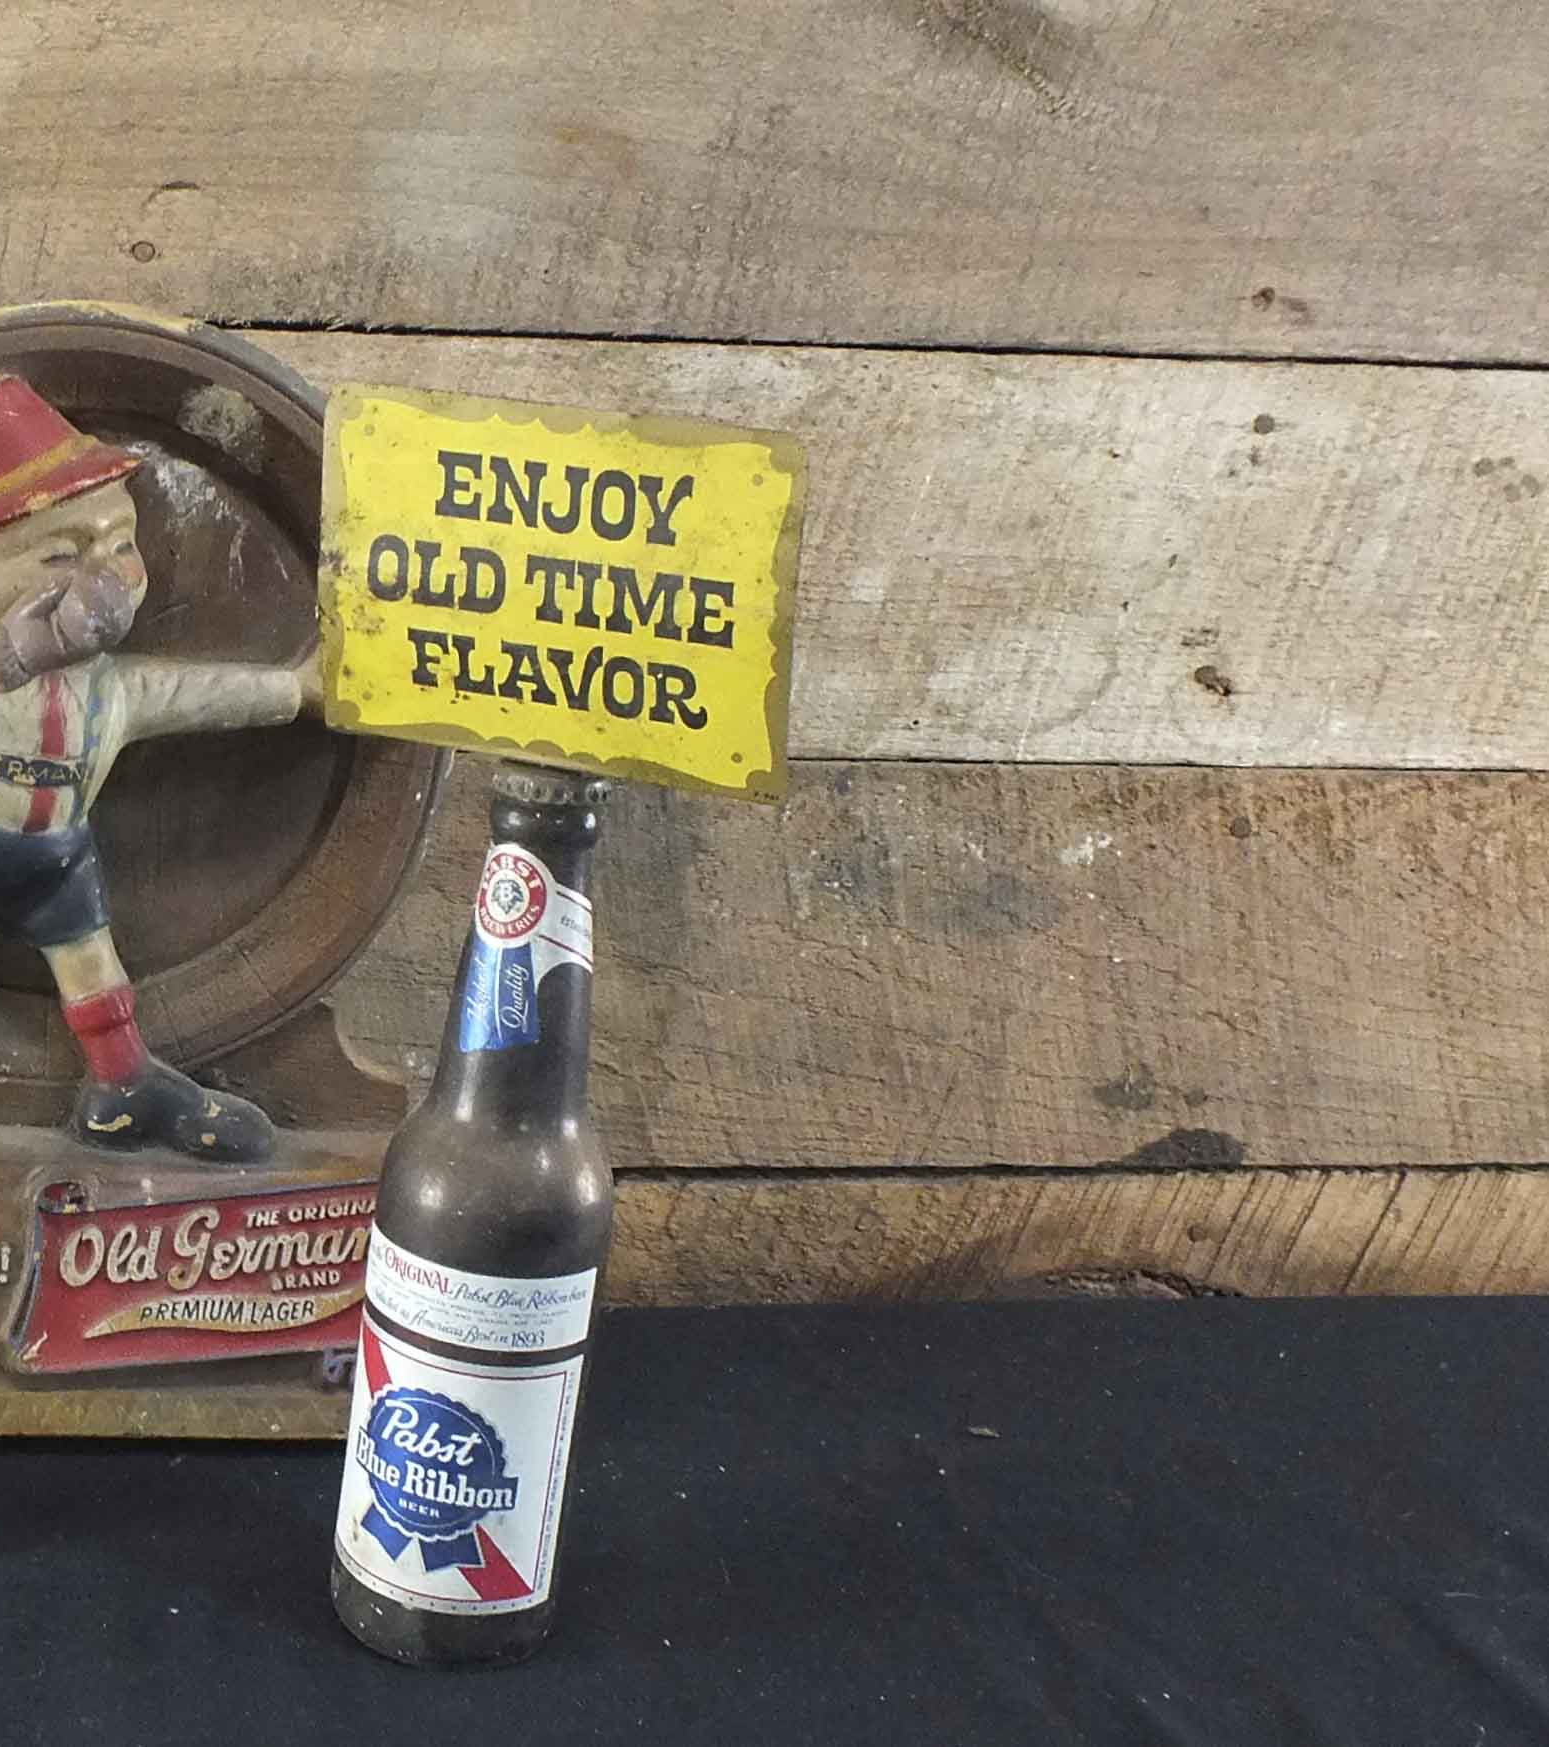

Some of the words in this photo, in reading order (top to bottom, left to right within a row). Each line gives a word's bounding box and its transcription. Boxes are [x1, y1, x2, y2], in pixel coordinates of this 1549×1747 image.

[435, 449, 694, 546] ENJOY
[366, 533, 507, 614] OLD
[524, 554, 735, 649] TIME
[407, 627, 708, 730] FLAVOR
[499, 962, 530, 1033] Quality
[243, 1208, 281, 1229] THE
[288, 1197, 378, 1223] ORIGINA
[59, 1223, 164, 1288] Old
[271, 1270, 340, 1291] BRAND
[385, 1249, 454, 1297] ORIGINAL
[452, 1281, 494, 1304] Pabst
[496, 1287, 528, 1308] Blue
[139, 1299, 248, 1323] PREMIUM
[251, 1299, 315, 1324] LAGER
[509, 1328, 546, 1348] 1893
[381, 1398, 483, 1467] Pabst
[355, 1430, 401, 1487] Blue
[402, 1458, 514, 1510] Ribbon
[398, 1497, 441, 1519] BEER
